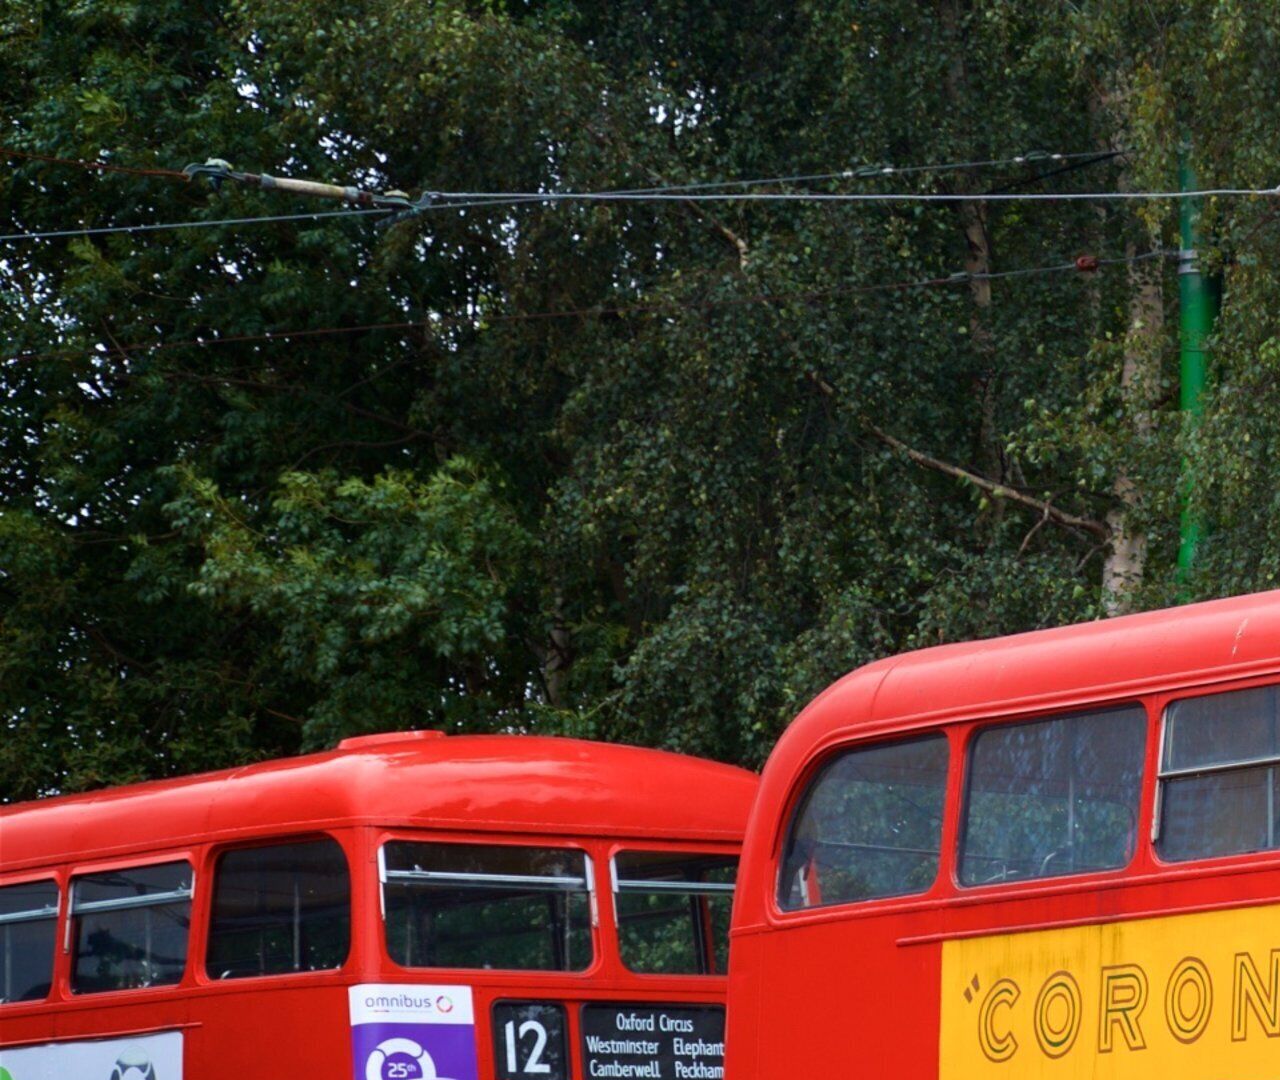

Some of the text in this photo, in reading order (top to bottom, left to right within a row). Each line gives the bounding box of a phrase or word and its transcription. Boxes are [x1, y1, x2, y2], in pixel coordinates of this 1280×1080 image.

[364, 994, 432, 1008] omnibus
[616, 1013, 694, 1033] Oxford Circus
[505, 1020, 550, 1074] 12
[586, 1036, 659, 1055] Westminster
[673, 1037, 725, 1060] Elephant
[387, 1062, 417, 1078] 25th
[589, 1060, 661, 1078] Camberwell
[675, 1060, 725, 1079] Peckham
